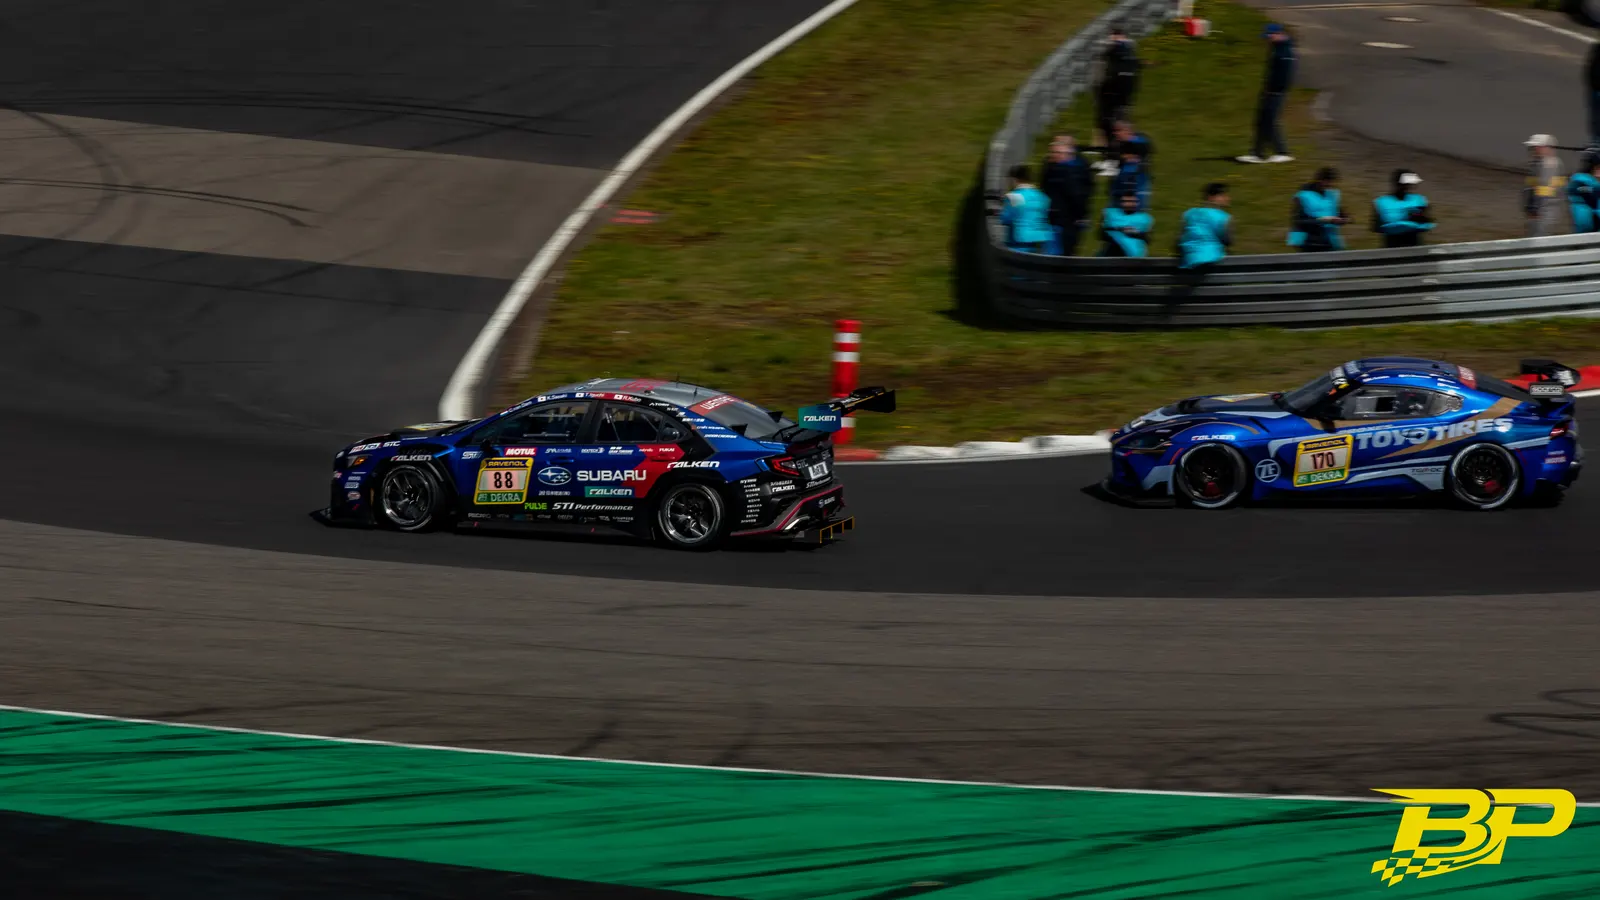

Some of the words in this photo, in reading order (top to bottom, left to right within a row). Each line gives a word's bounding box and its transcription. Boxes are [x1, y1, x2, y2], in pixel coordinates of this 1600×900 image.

[1355, 427, 1430, 450] TOYO
[1431, 417, 1514, 441] TIRES
[506, 448, 536, 456] MOTUL
[667, 460, 720, 469] FALKEN
[1310, 451, 1336, 470] 170
[494, 472, 513, 489] 88
[576, 470, 647, 482] SUBARU
[1310, 470, 1344, 483] DEKRA
[772, 485, 795, 493] FALKEN
[490, 494, 521, 502] DEKRA
[552, 502, 575, 511] STI
